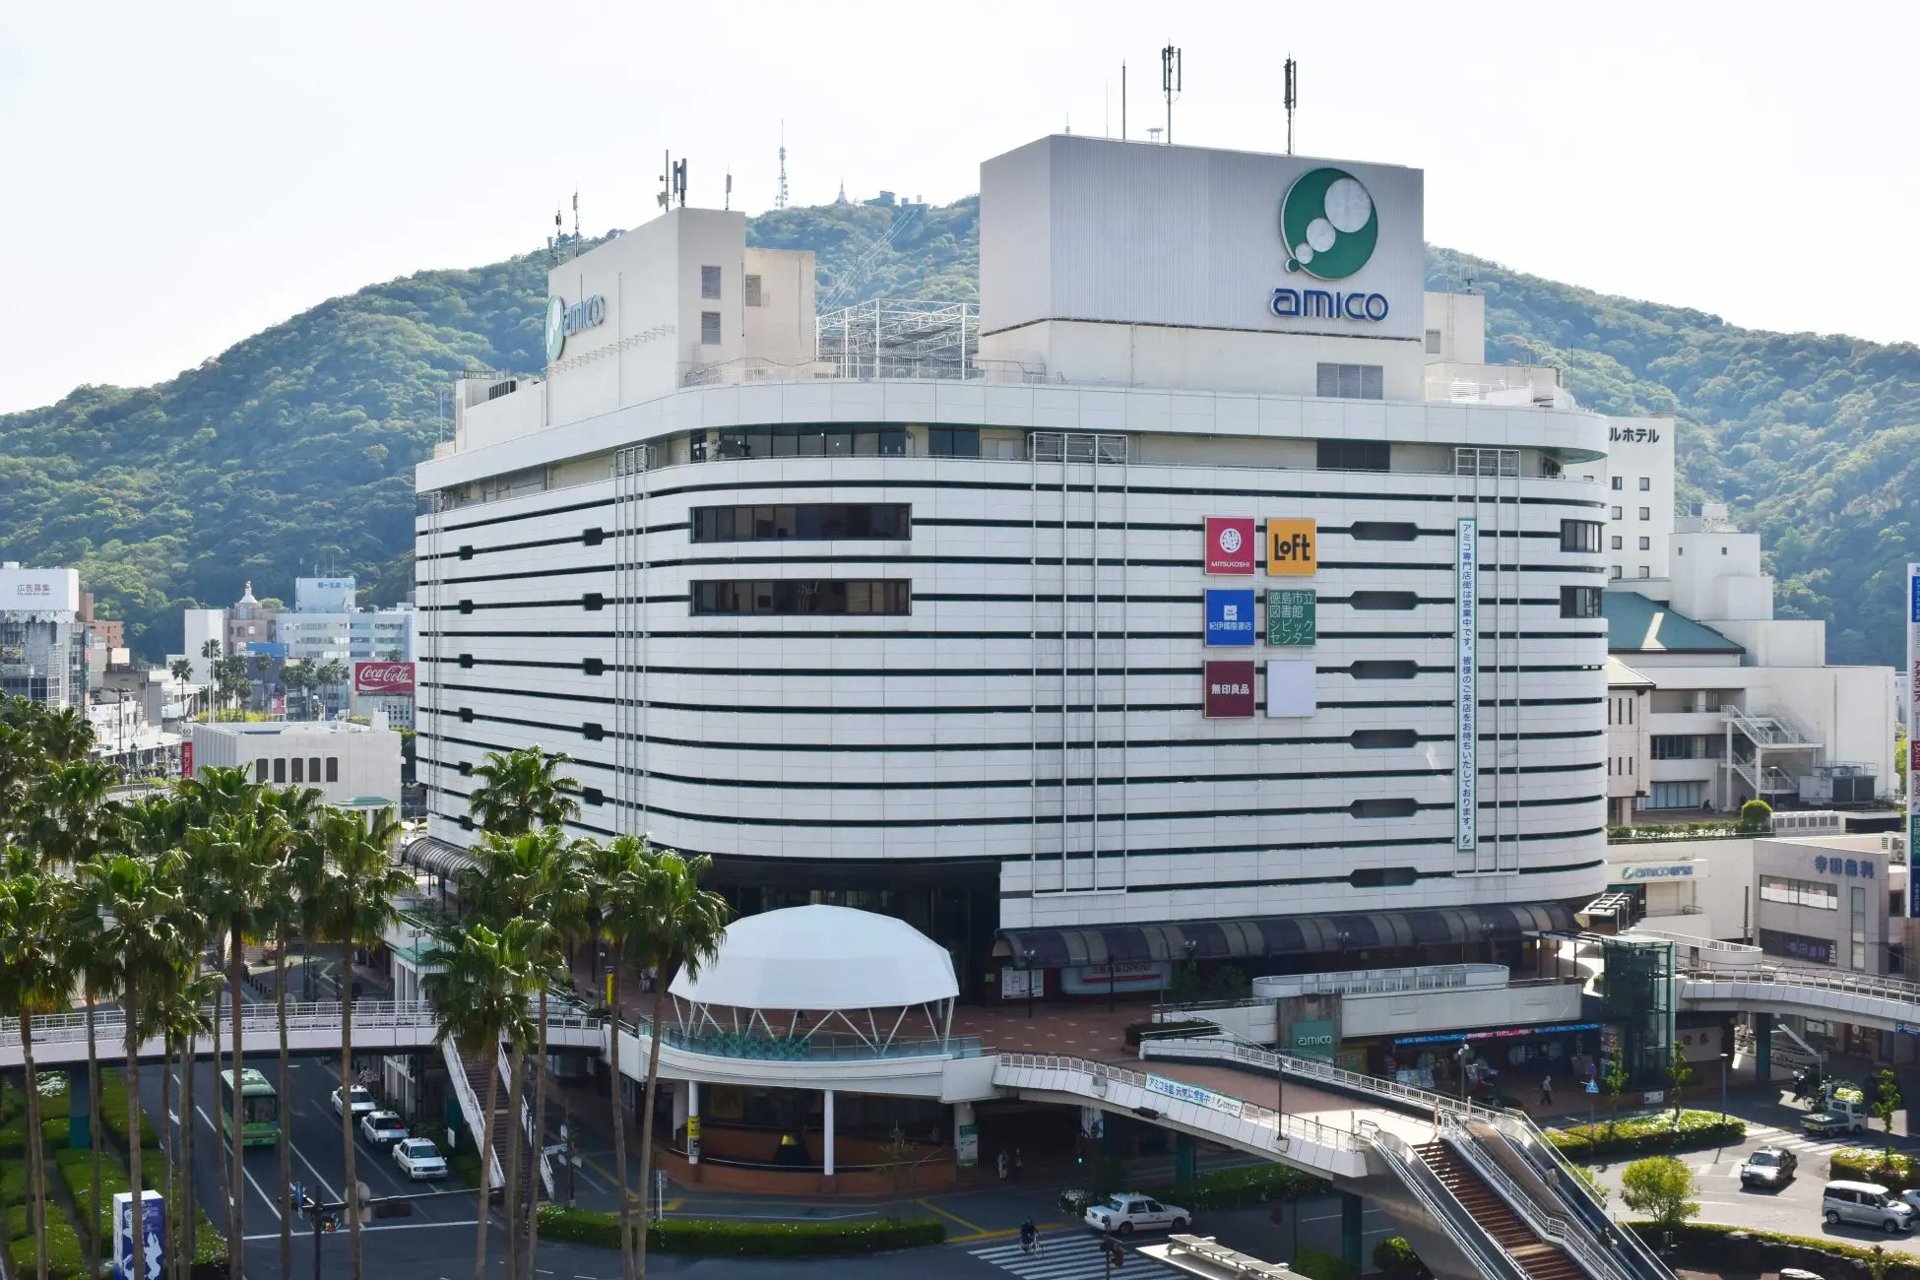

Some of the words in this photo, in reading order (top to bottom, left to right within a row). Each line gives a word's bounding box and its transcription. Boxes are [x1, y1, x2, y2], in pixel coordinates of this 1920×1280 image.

[1271, 288, 1389, 322] amico
[1609, 427, 1660, 444] ルホテル
[1211, 560, 1250, 568] MITSUKOSHI
[16, 583, 50, 592] 広告募集
[1269, 592, 1315, 605] 徳島市立
[1269, 605, 1304, 618] 図書館
[1269, 619, 1314, 632] シビック
[1269, 632, 1314, 645] センター
[1211, 683, 1250, 695] 無印良品
[1297, 1034, 1333, 1047] amico
